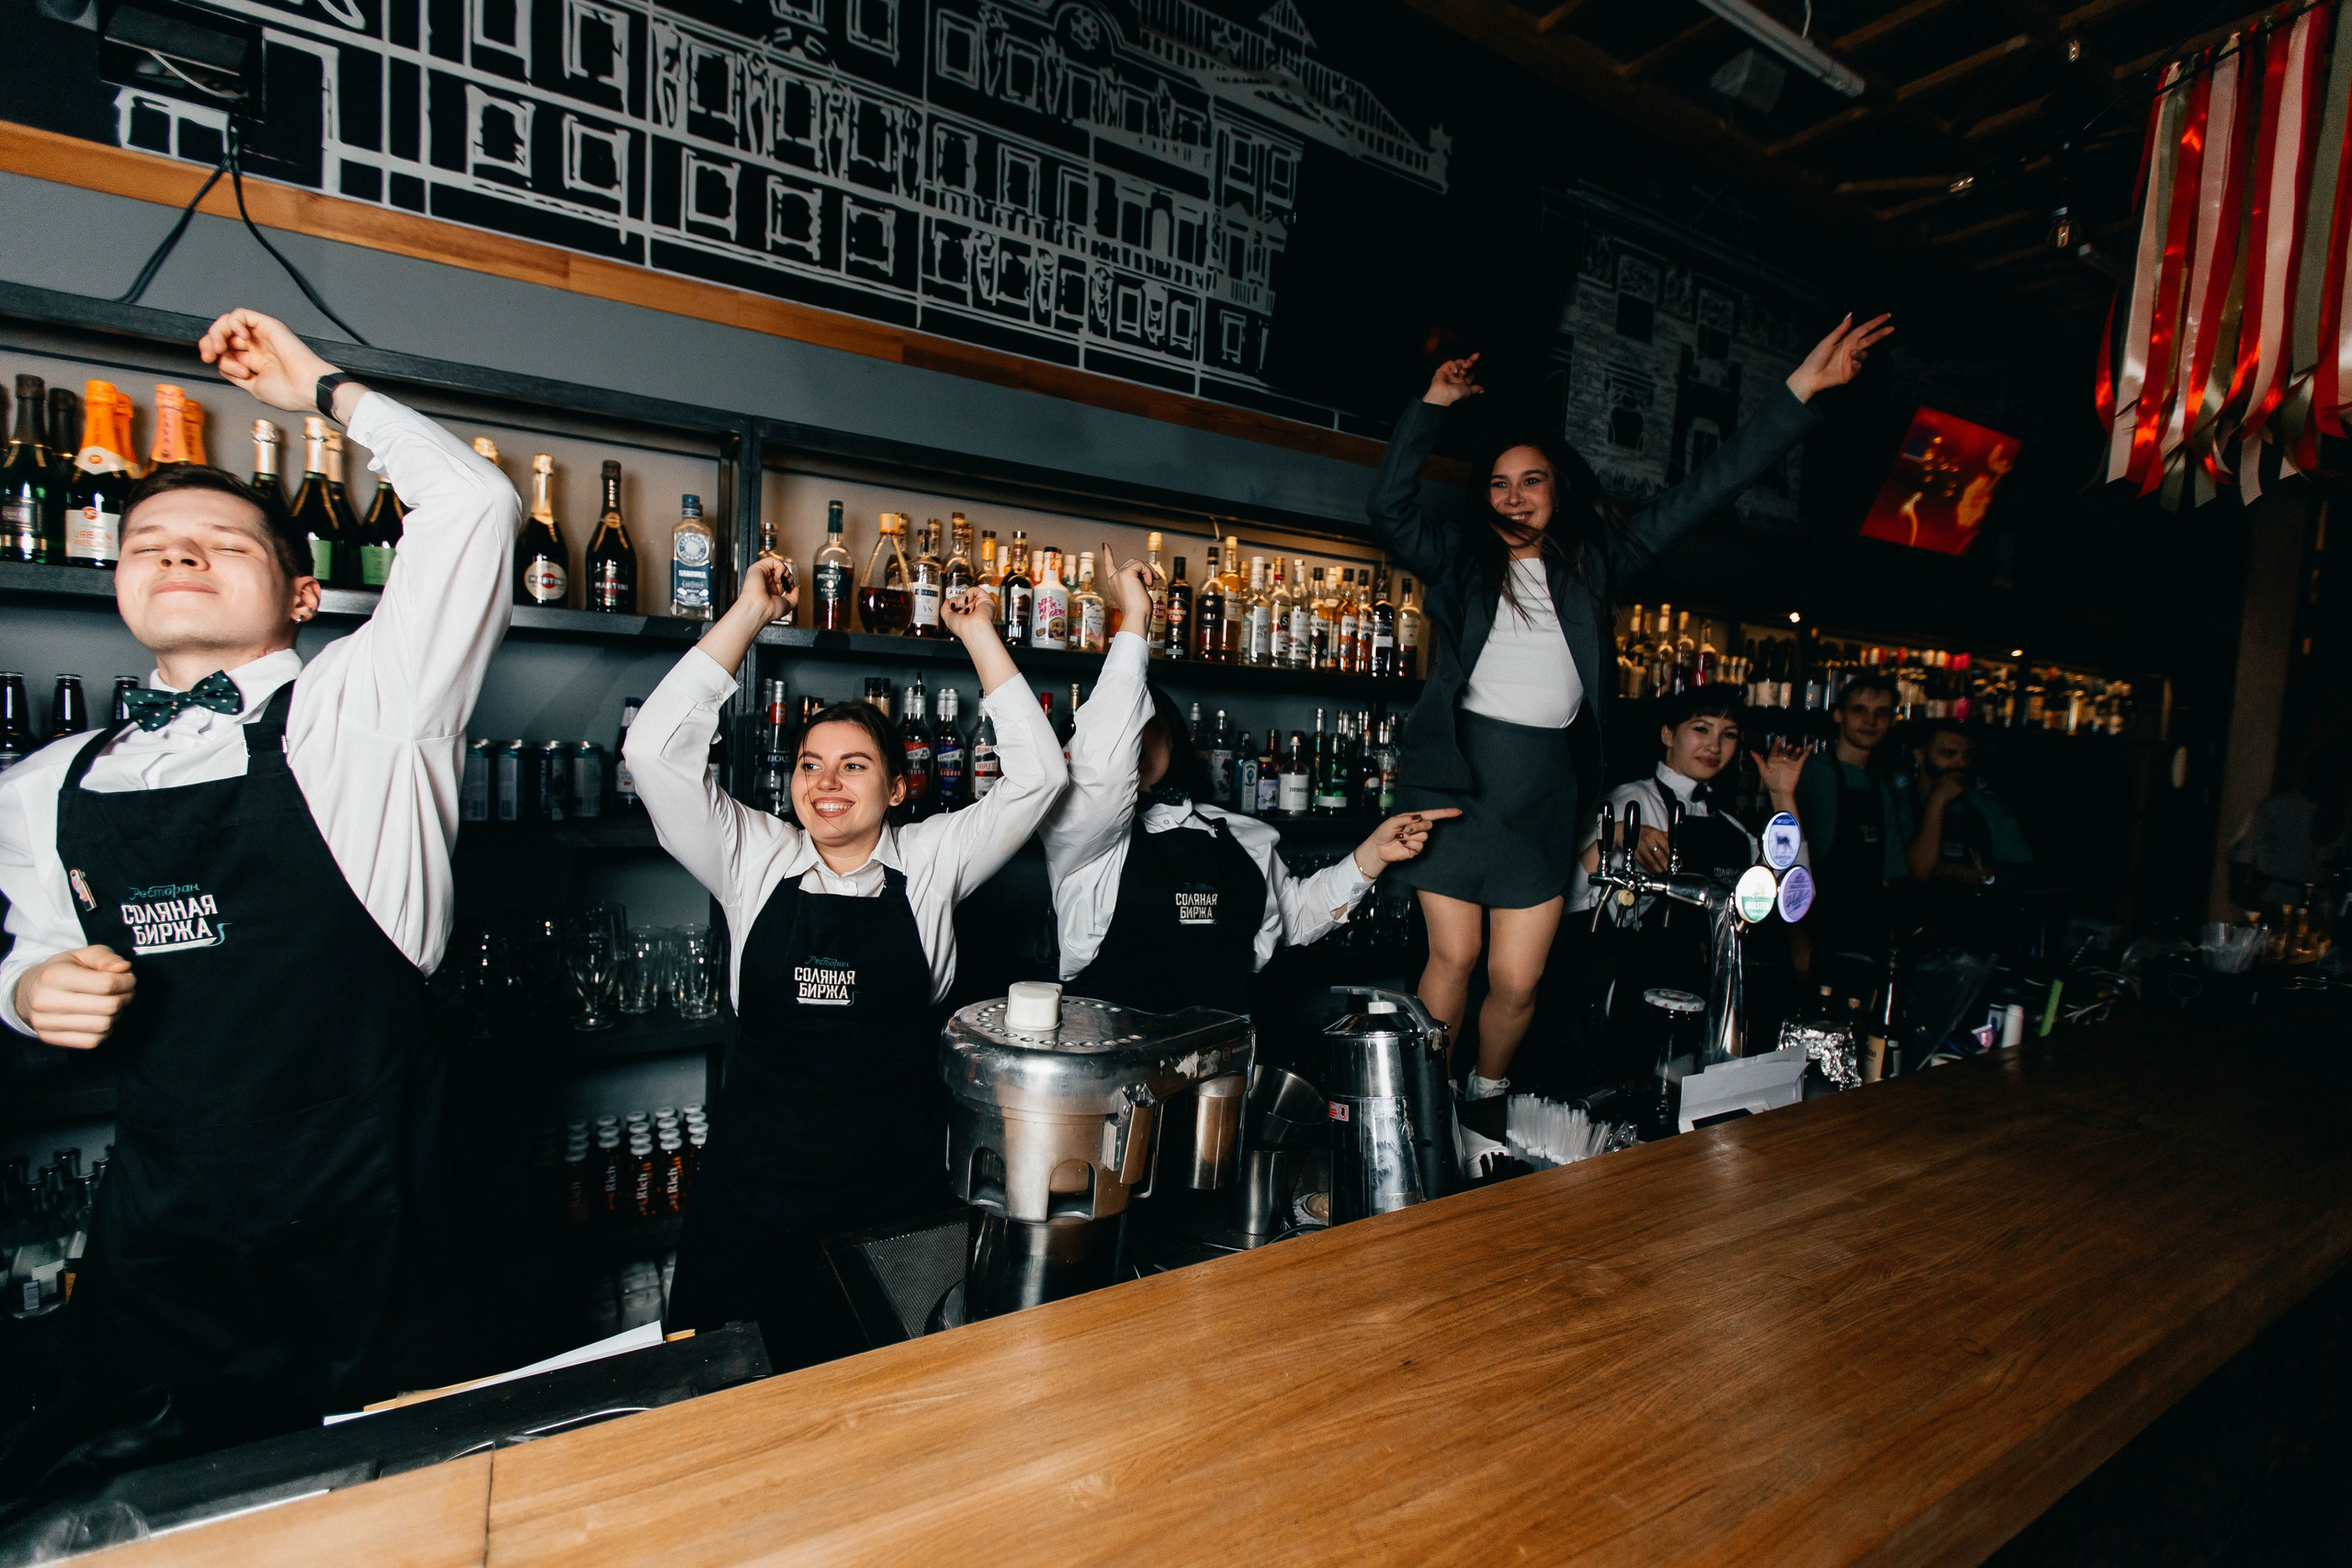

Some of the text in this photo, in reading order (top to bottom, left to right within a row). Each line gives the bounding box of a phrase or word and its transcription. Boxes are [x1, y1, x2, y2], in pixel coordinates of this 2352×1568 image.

[594, 581, 629, 592] MARTINI
[766, 754, 791, 762] BOLS
[128, 884, 200, 901] Ресторан
[1175, 892, 1218, 906] СОЛЯНАЯ
[120, 894, 218, 925] СОЛЯНАЯ
[1180, 906, 1213, 919] БИРЖА
[132, 917, 214, 945] БИРЖА
[805, 955, 850, 969] Ресторан
[794, 966, 856, 986] СОЛЯНАЯ
[798, 982, 849, 999] БИРЖА
[636, 1173, 648, 1200] Rich
[666, 1166, 679, 1194] Rich
